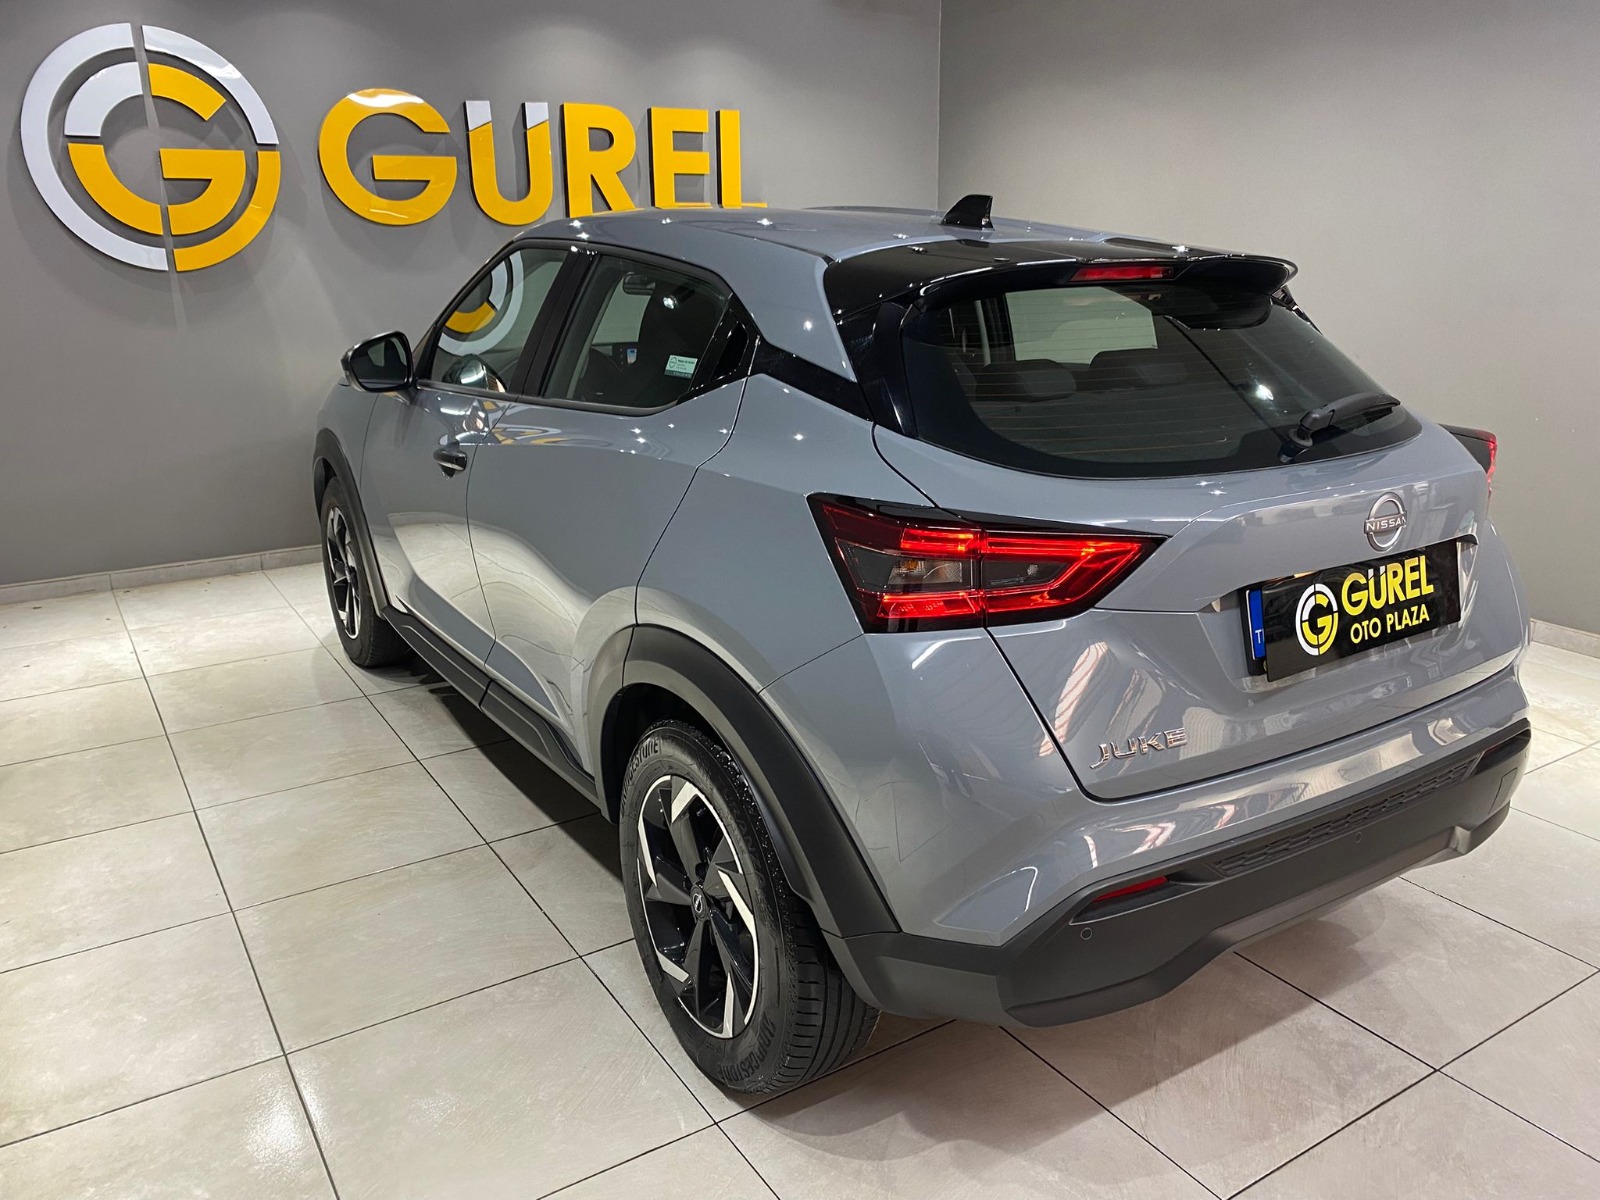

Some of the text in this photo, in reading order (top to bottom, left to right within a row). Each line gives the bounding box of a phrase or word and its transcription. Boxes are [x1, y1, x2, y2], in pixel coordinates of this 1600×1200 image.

[1366, 515, 1407, 531] NISSAN
[1350, 604, 1430, 644] OTO PLAZA
[1090, 727, 1188, 769] JUKE
